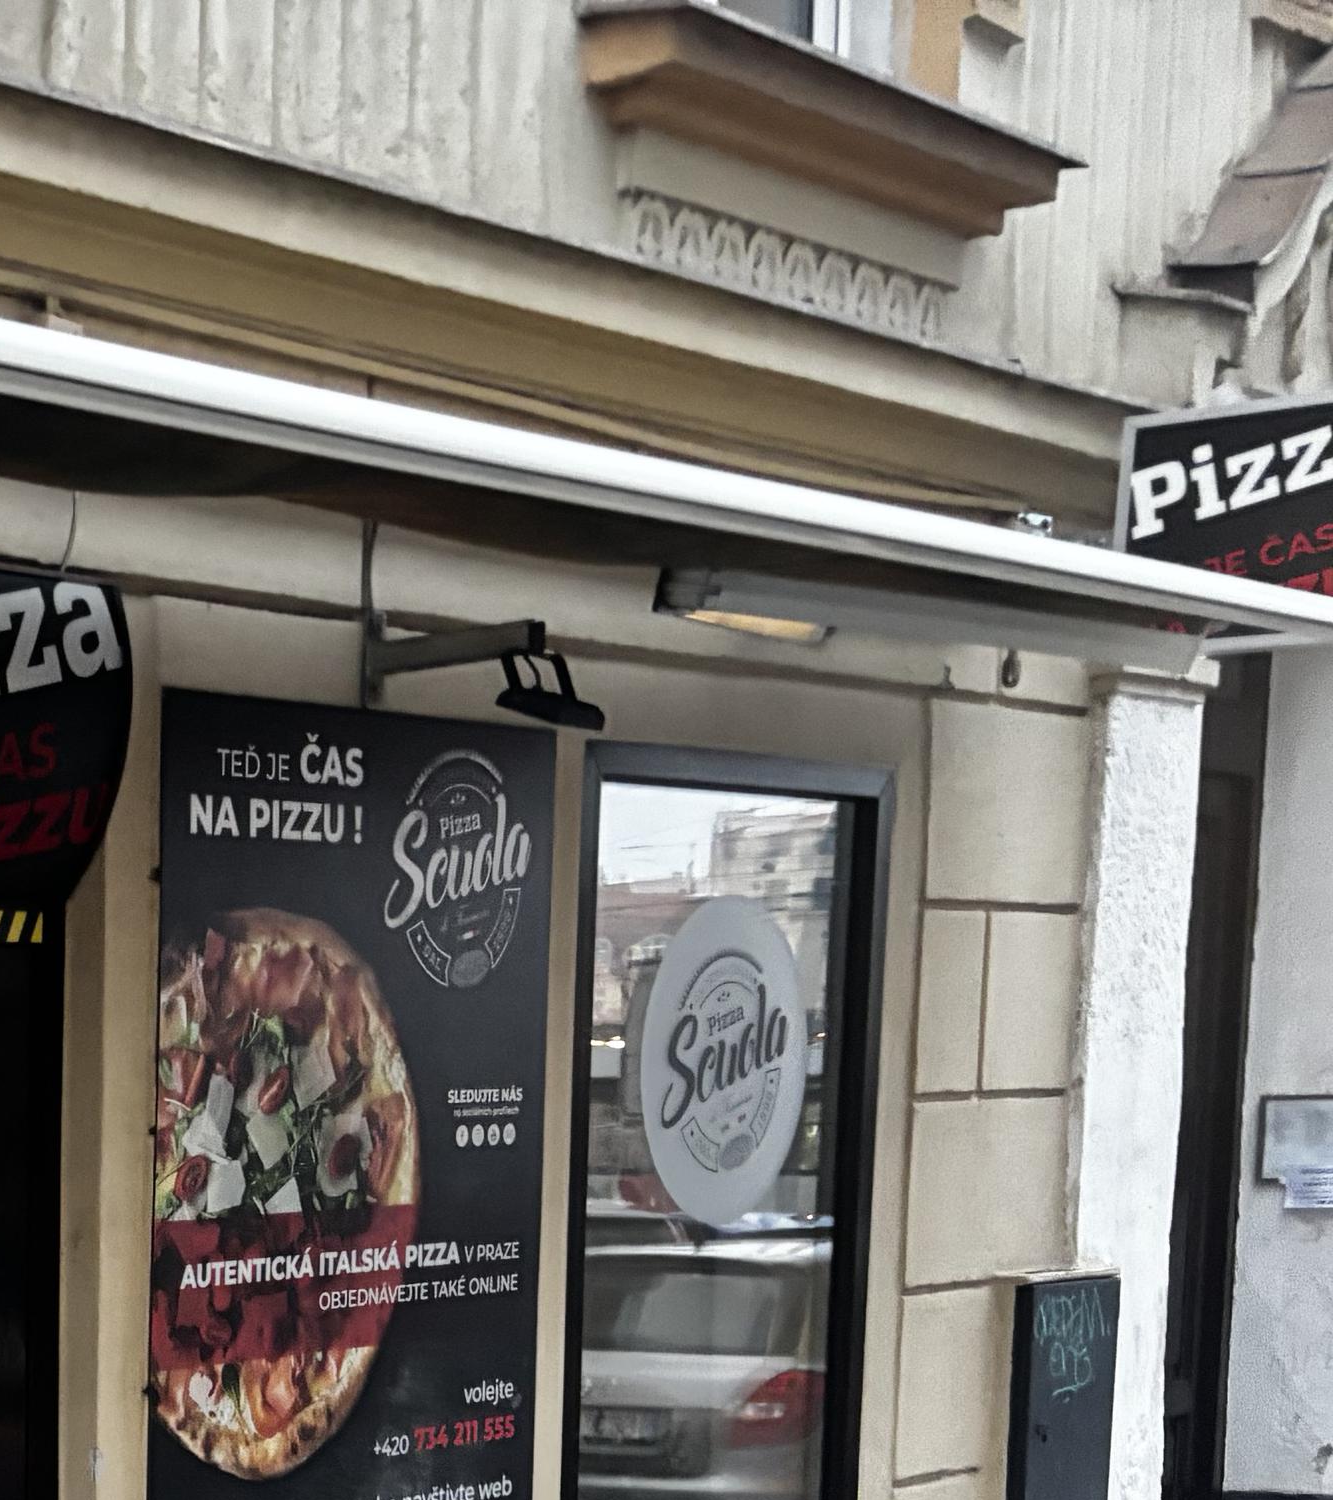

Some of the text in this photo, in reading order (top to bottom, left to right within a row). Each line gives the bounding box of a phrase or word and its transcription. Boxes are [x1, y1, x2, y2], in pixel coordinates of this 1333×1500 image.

[217, 733, 363, 786] TEĎ JE ČAS
[189, 794, 344, 843] NA PIZZU
[440, 812, 481, 839] Pizza
[384, 794, 531, 928] Scuola
[708, 1004, 744, 1035] Pizza
[661, 983, 787, 1129] Scuola
[447, 1086, 523, 1103] SLEDUJTE NÁS
[181, 1241, 519, 1289] AUTENTICKÁ ITALSKÁ PIZZA V PRAZE
[319, 1273, 518, 1311] OBJEDNÁVEJTE TAKÉ ONLINE
[464, 1379, 514, 1407] volejte
[374, 1435, 409, 1457] +420
[454, 1420, 478, 1446] 211
[484, 1415, 515, 1441] 555
[478, 1474, 512, 1498] web
